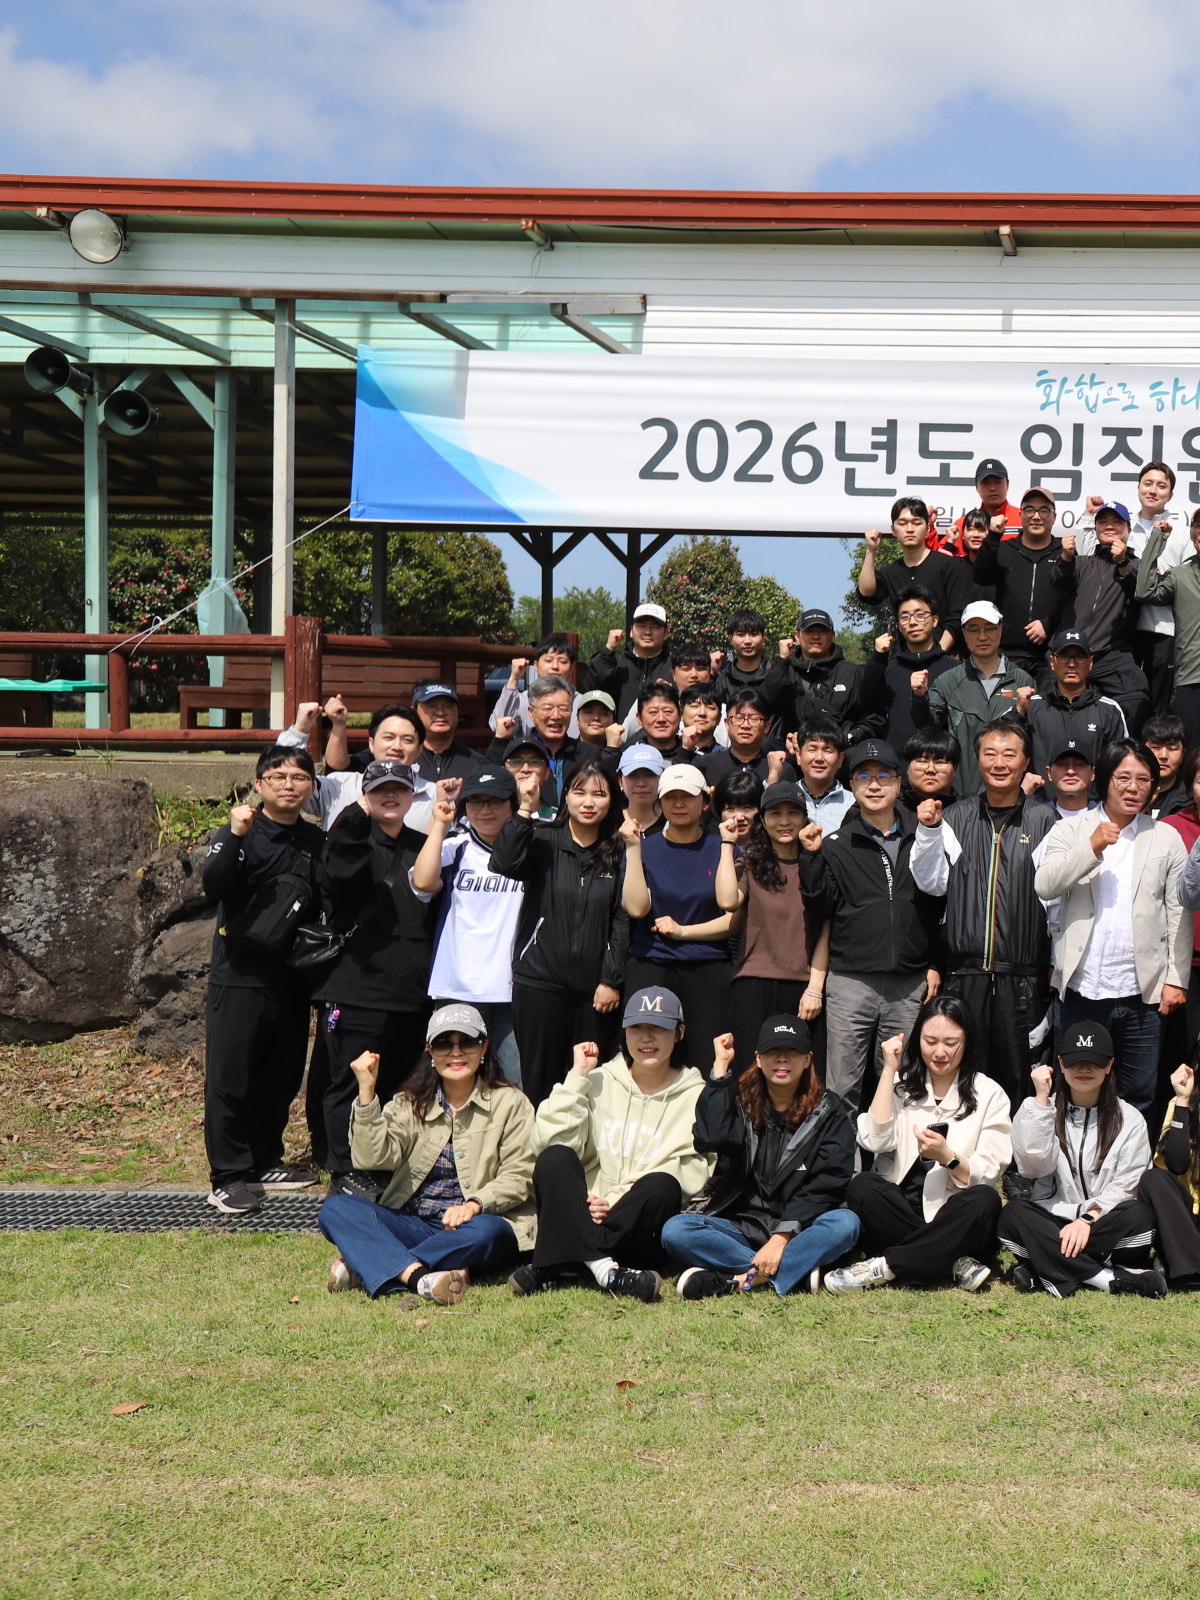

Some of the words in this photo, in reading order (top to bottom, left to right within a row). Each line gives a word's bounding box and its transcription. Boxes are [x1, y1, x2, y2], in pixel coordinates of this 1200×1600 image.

[1036, 369, 1139, 415] 화합으로
[638, 417, 977, 497] 2026년도
[638, 995, 664, 1013] M
[774, 1025, 796, 1035] UCLA
